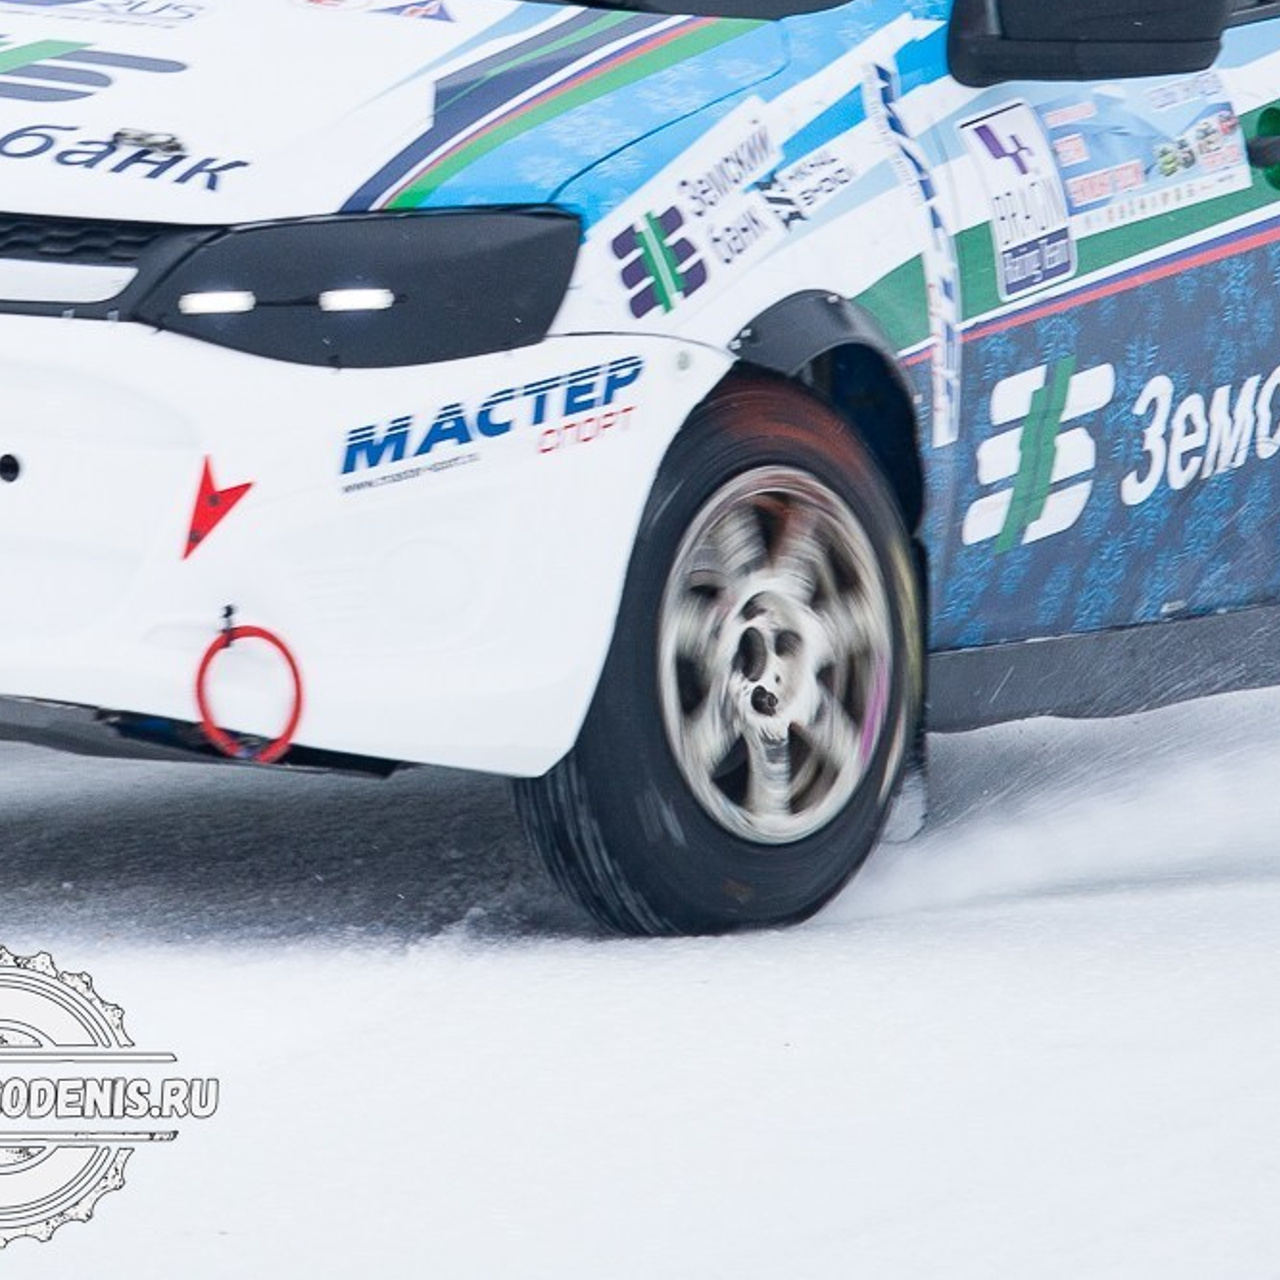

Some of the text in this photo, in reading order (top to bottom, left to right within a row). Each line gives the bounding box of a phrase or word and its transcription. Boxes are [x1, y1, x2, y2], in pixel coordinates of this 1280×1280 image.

[677, 118, 773, 218] Земский
[709, 203, 772, 266] банк
[340, 355, 645, 475] МАСТЕР
[538, 405, 636, 454] СПОРТ
